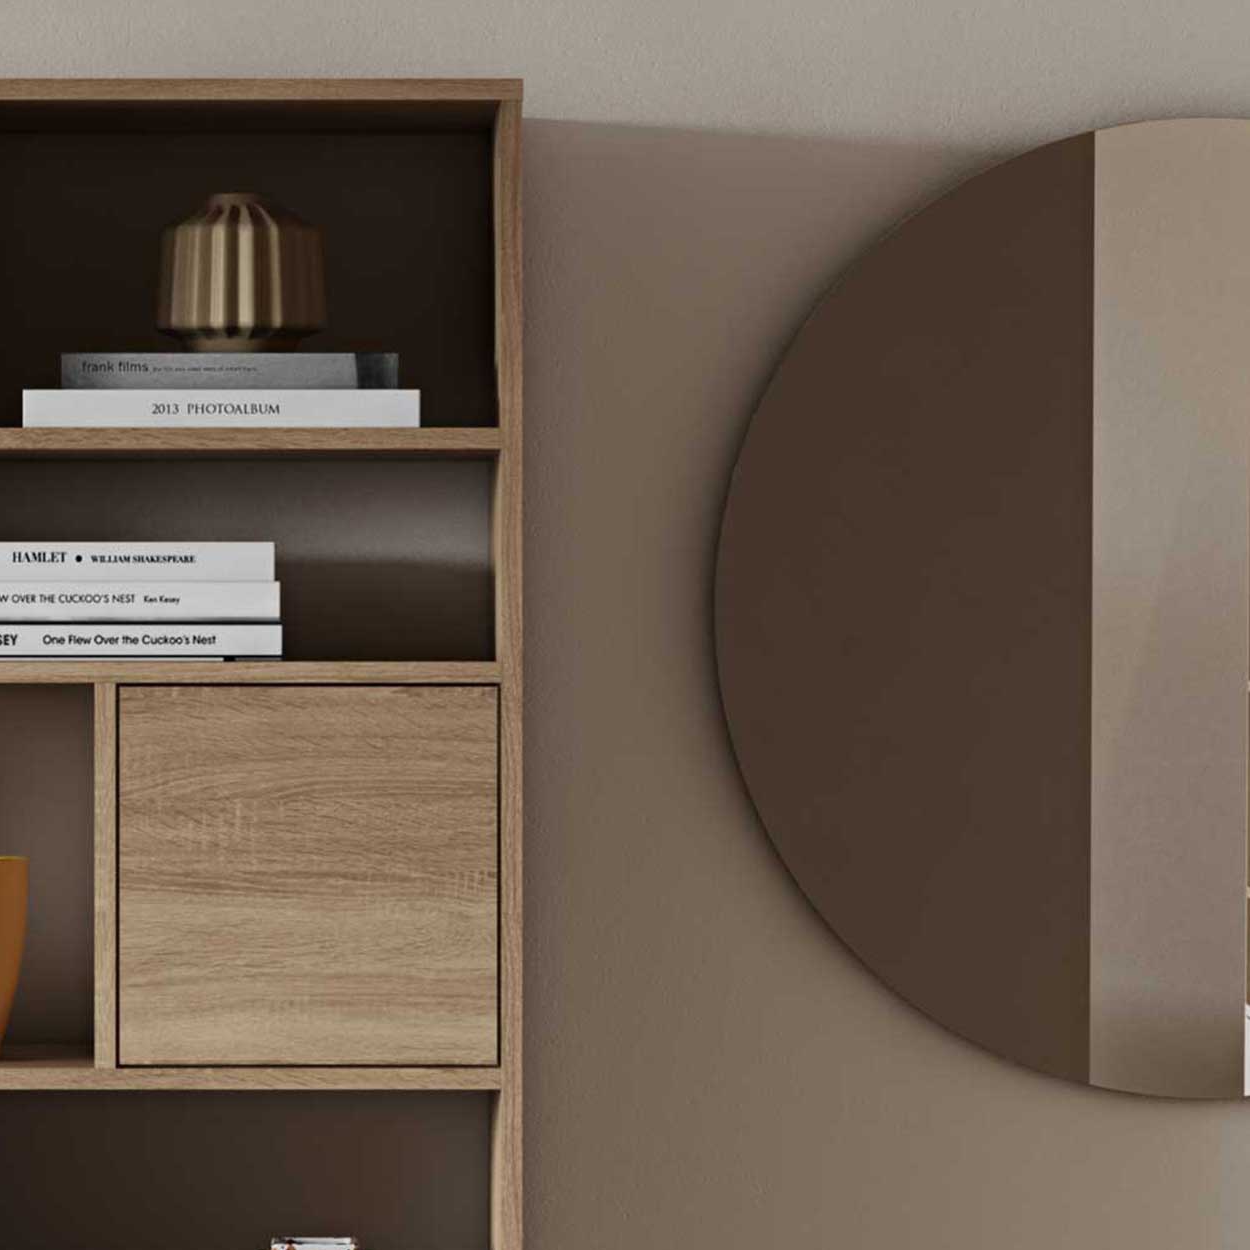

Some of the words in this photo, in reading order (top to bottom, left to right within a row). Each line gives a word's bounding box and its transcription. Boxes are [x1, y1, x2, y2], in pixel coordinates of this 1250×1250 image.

[81, 361, 115, 373] frank
[118, 361, 149, 373] films
[152, 403, 180, 415] 2013
[187, 403, 281, 415] PHOTOALBUM
[11, 551, 68, 564] HAMLET
[90, 555, 130, 564] WILLIAM
[132, 555, 197, 564] SHAKESPEARE
[11, 593, 37, 604] OVER
[39, 593, 56, 604] THE
[58, 593, 110, 604] CUCKOO'S
[112, 593, 135, 604] NEST
[144, 595, 157, 604] Ken
[159, 595, 180, 606] Kesey
[42, 635, 66, 646] One
[67, 634, 92, 646] Flew
[93, 635, 120, 646] Over
[121, 635, 140, 646] the
[141, 635, 191, 646] Cuckoo's
[192, 635, 217, 646] Nest
